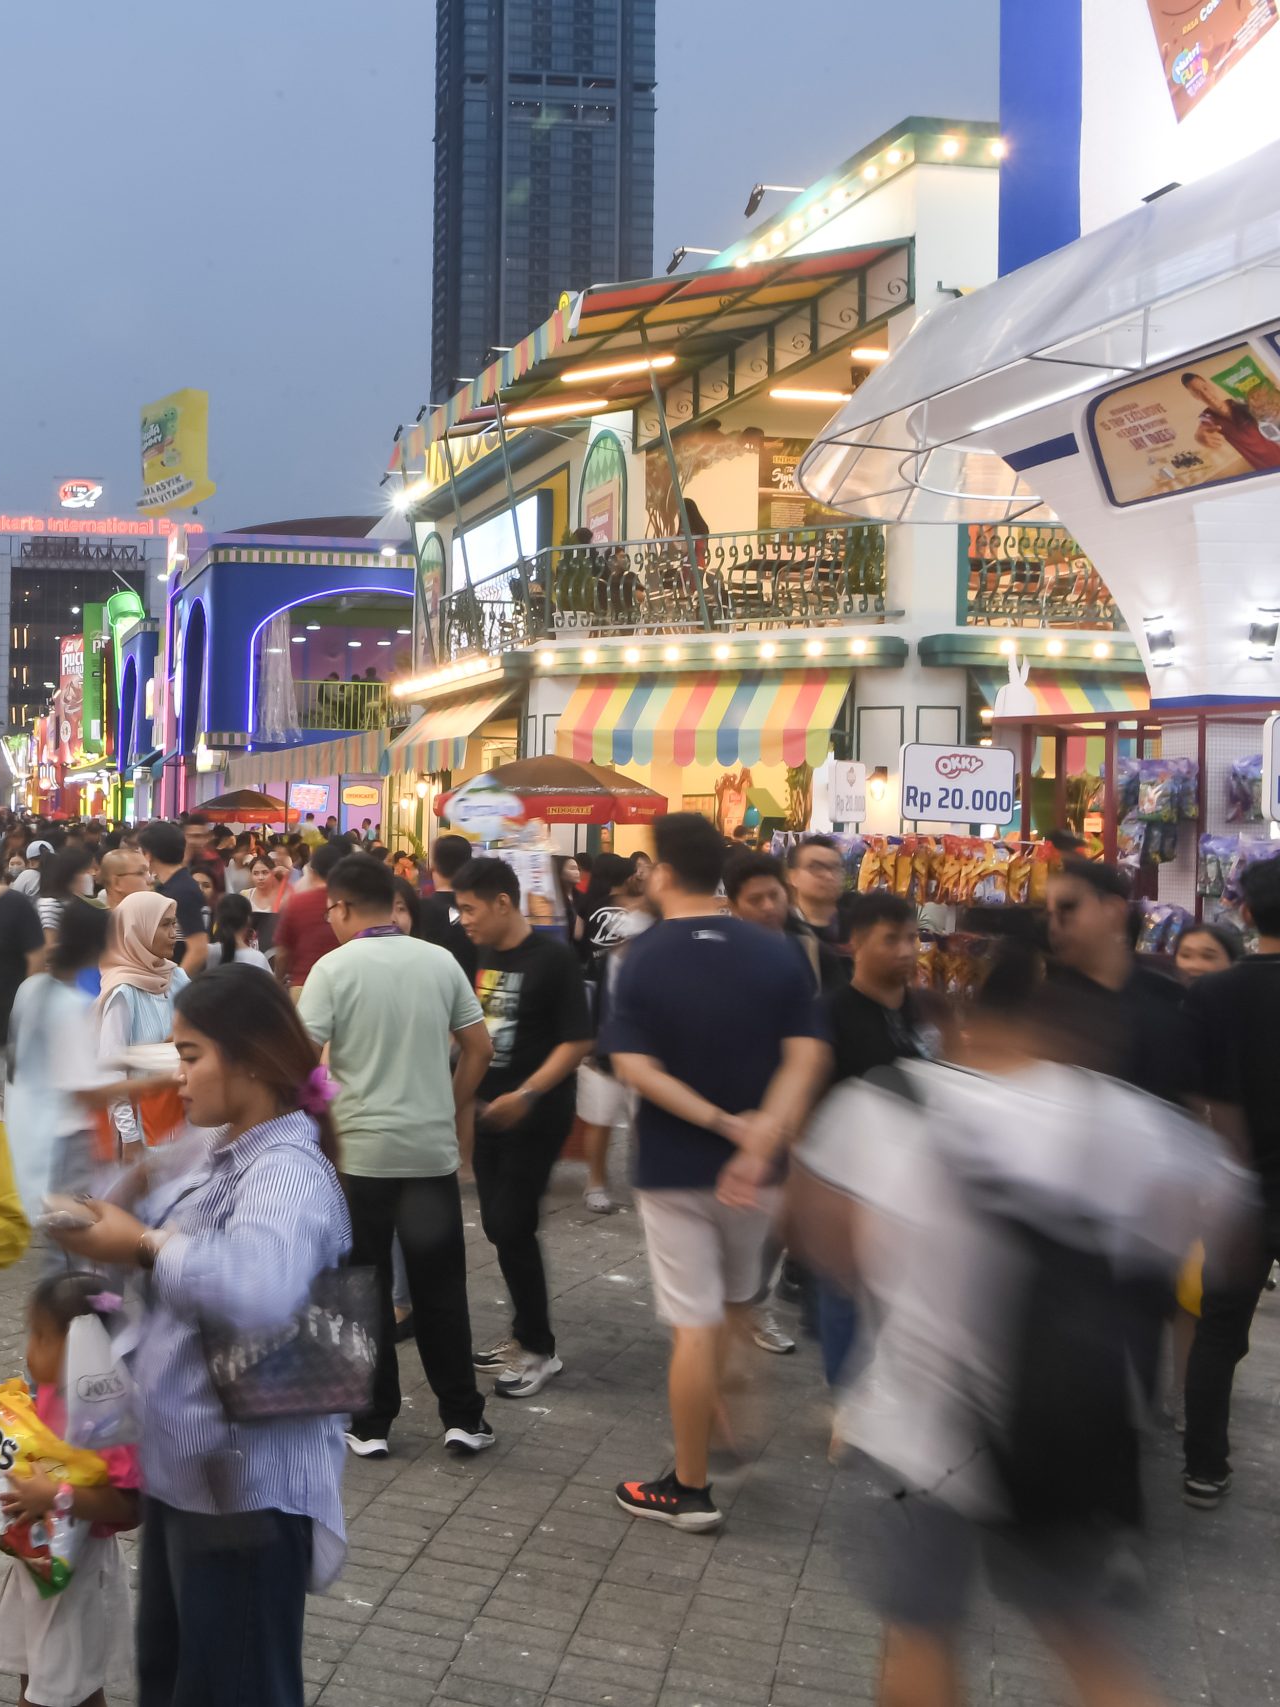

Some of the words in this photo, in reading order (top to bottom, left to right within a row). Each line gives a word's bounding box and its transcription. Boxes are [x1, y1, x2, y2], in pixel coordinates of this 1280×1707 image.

[47, 516, 154, 535] International
[905, 785, 931, 813] Rp
[937, 787, 1012, 813] 20.000
